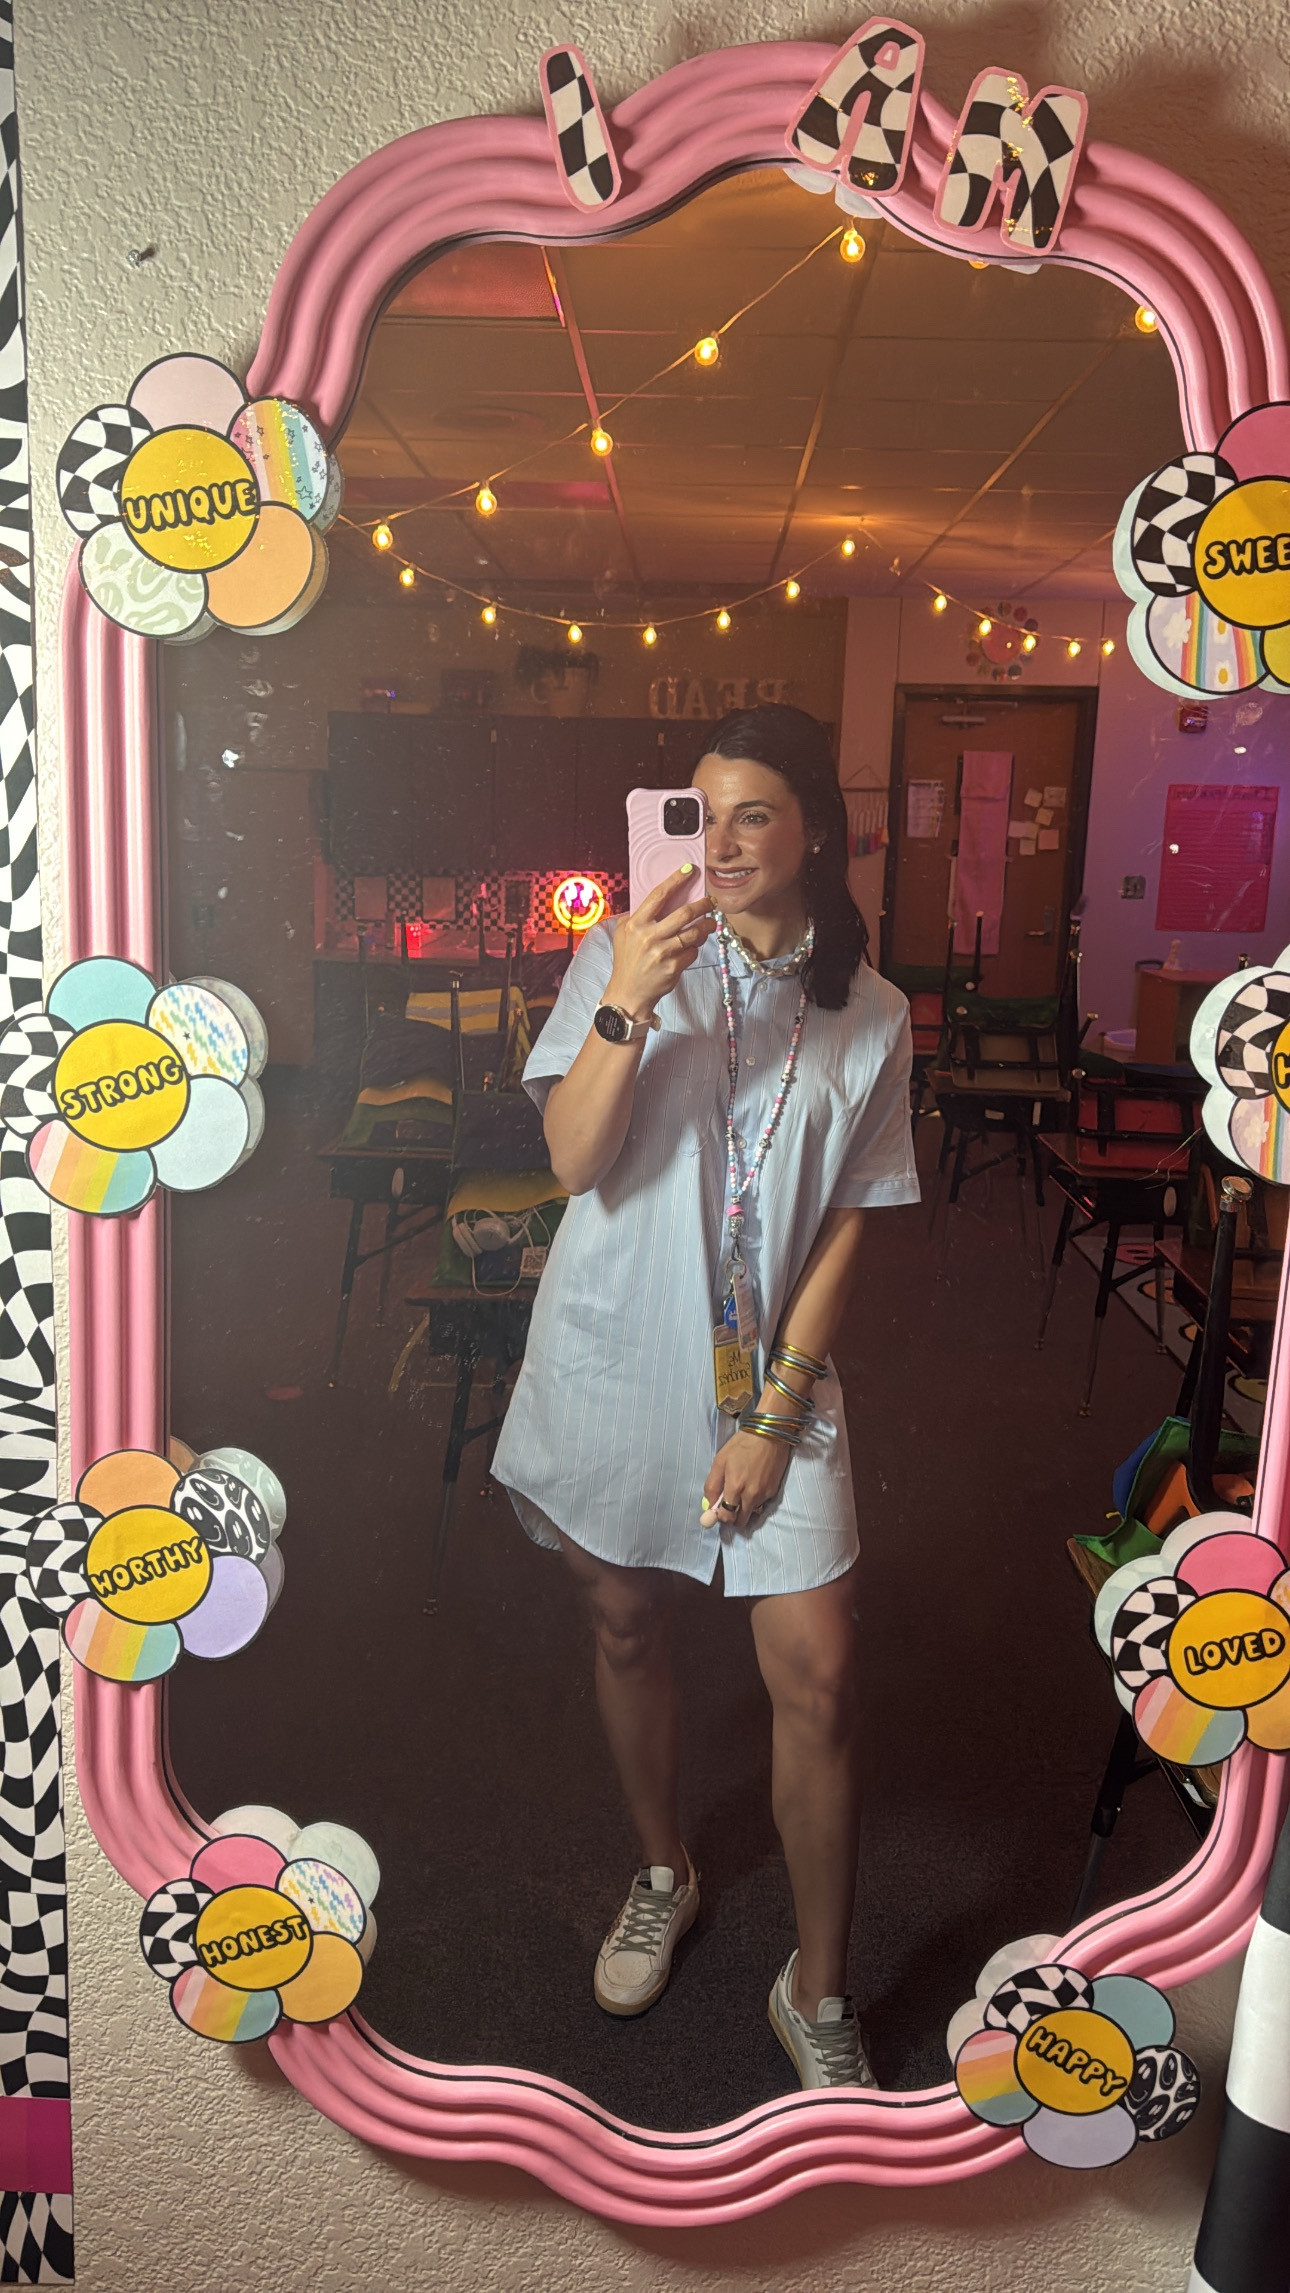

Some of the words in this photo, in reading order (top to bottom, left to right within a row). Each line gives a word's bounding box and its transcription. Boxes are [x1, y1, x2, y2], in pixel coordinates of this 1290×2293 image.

[540, 44, 622, 214] I
[785, 16, 1089, 256] AM
[123, 478, 258, 533] UNIQUE
[60, 1055, 184, 1120] STRONG
[88, 1535, 204, 1599] WORTHY
[1184, 1627, 1286, 1676] LOVED
[198, 1915, 308, 1968] HONEST
[1025, 2026, 1128, 2097] HAPPY
